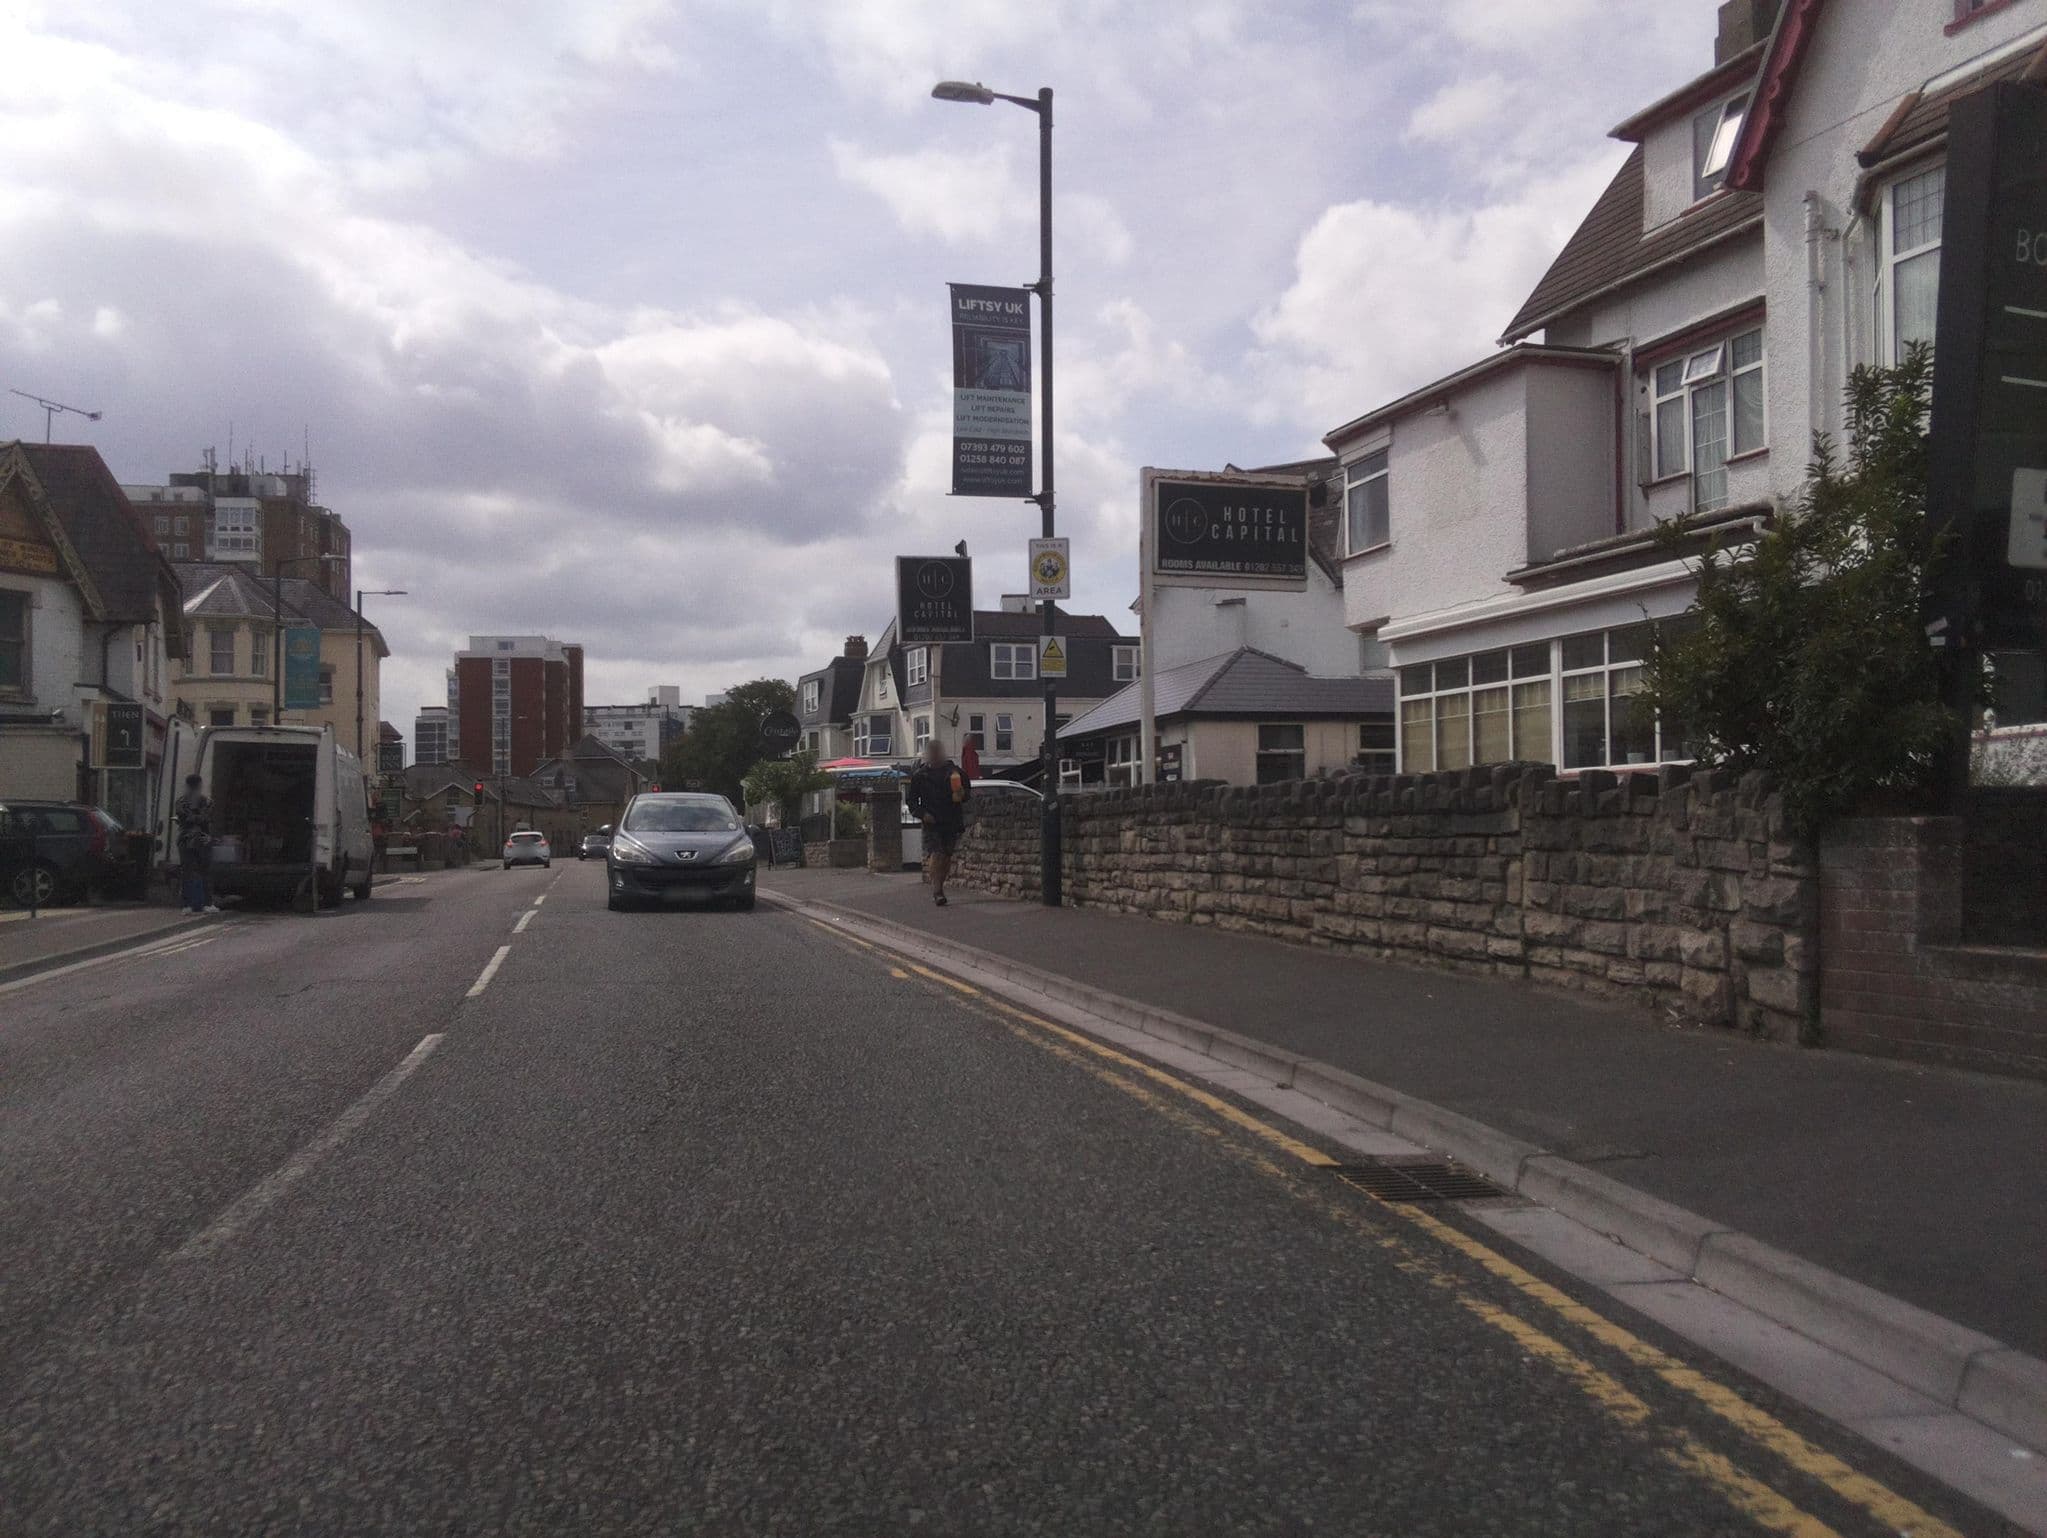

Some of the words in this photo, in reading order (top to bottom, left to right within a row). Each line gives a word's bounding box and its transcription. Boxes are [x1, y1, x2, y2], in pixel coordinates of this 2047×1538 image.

[958, 298, 1002, 312] LIFTSY
[1005, 302, 1024, 314] UK
[977, 395, 1025, 404] MAINTENANCE
[960, 442, 988, 451] 07393
[990, 443, 1006, 453] 479
[1008, 445, 1025, 454] 602
[960, 454, 987, 463] 01258
[989, 455, 1007, 464] 840
[1009, 456, 1025, 465] 087
[1223, 506, 1286, 524] HOTEL
[1211, 524, 1298, 543] CAPITAL
[1162, 558, 1193, 569] ROOMS
[1195, 560, 1241, 571] AVAILABLE
[1036, 587, 1062, 595] AREA
